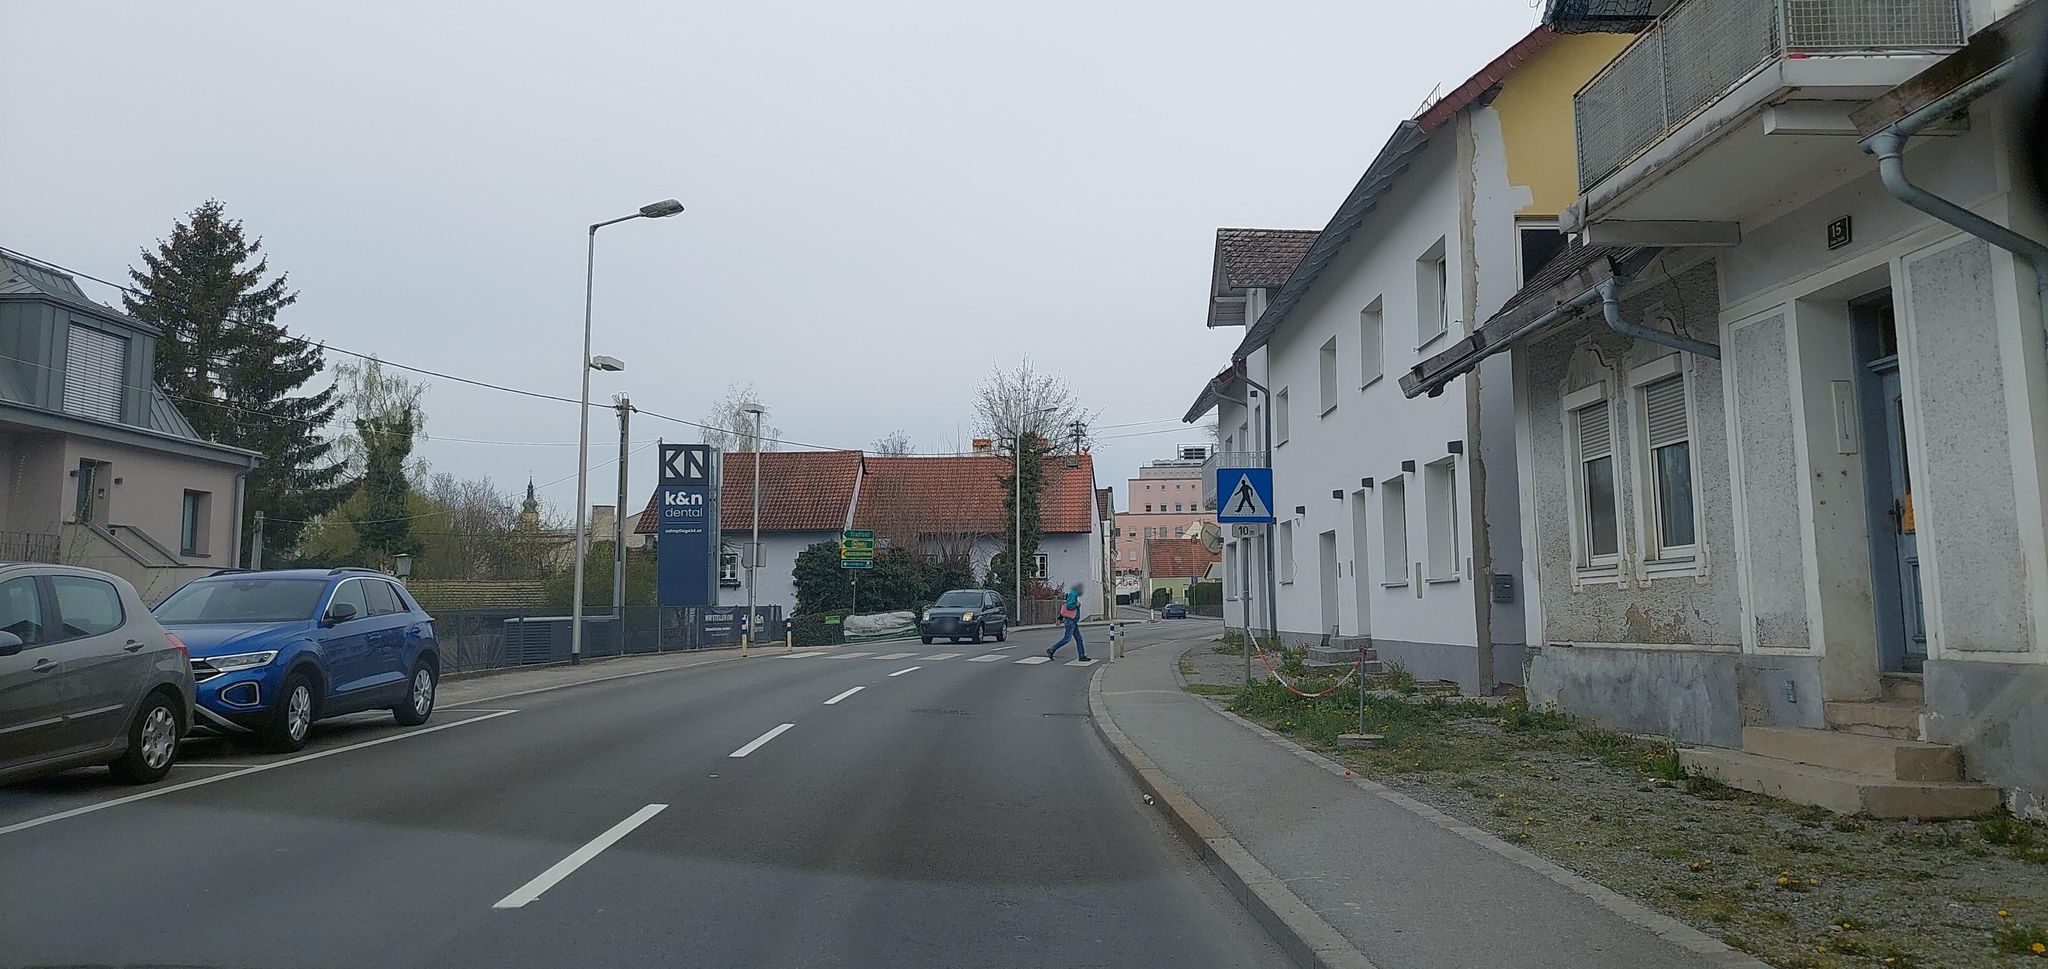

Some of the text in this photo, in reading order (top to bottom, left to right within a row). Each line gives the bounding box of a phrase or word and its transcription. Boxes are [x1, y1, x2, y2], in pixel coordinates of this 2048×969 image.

[1832, 222, 1842, 237] 15
[665, 450, 703, 478] KN
[665, 490, 703, 505] k&n
[665, 507, 703, 517] dental
[1238, 526, 1249, 535] 10
